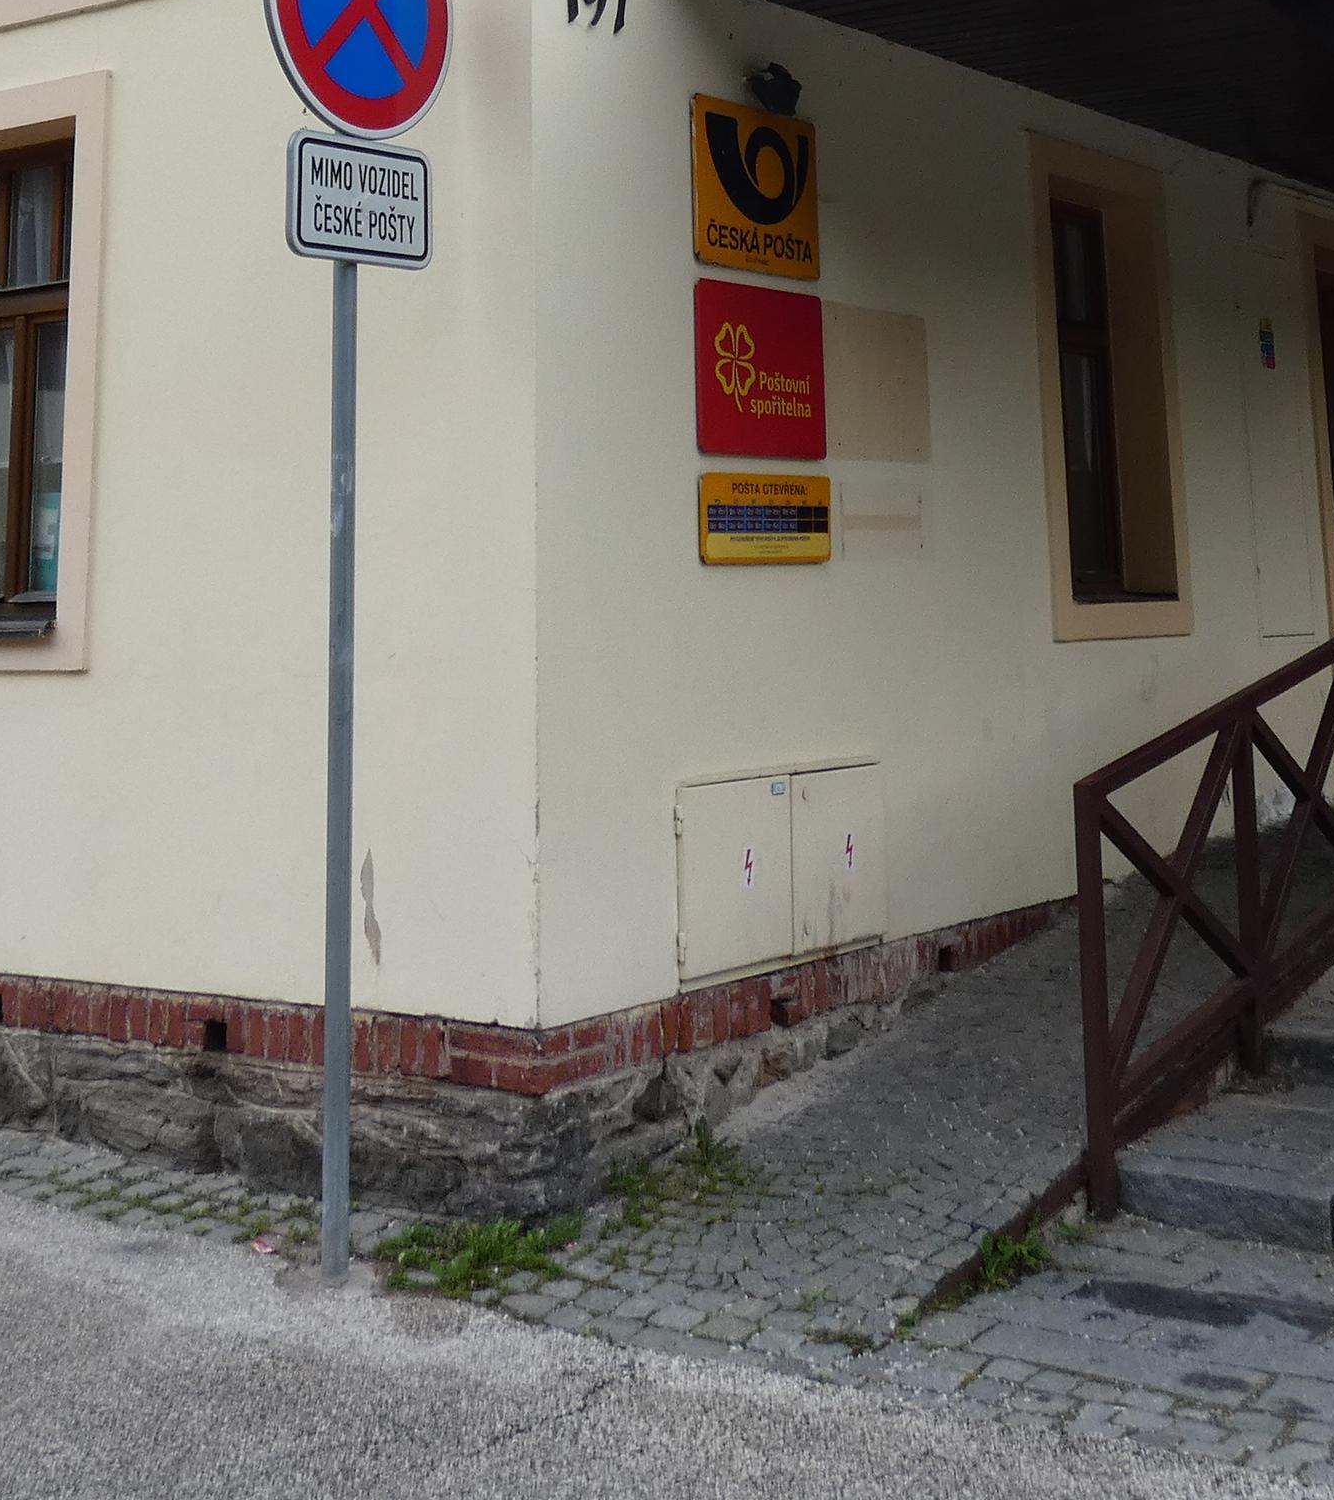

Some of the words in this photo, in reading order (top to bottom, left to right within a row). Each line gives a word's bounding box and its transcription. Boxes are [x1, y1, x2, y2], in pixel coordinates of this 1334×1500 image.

[311, 155, 353, 191] MIMO
[358, 163, 419, 202] VOZIDEL
[313, 194, 363, 238] ČESKÉ
[369, 205, 416, 245] POŠTY
[707, 218, 760, 255] ČESKÁ
[763, 231, 813, 265] POŠTA
[759, 371, 810, 395] Poštovní
[750, 395, 812, 420] spořitelna
[731, 480, 760, 495] POŠTA
